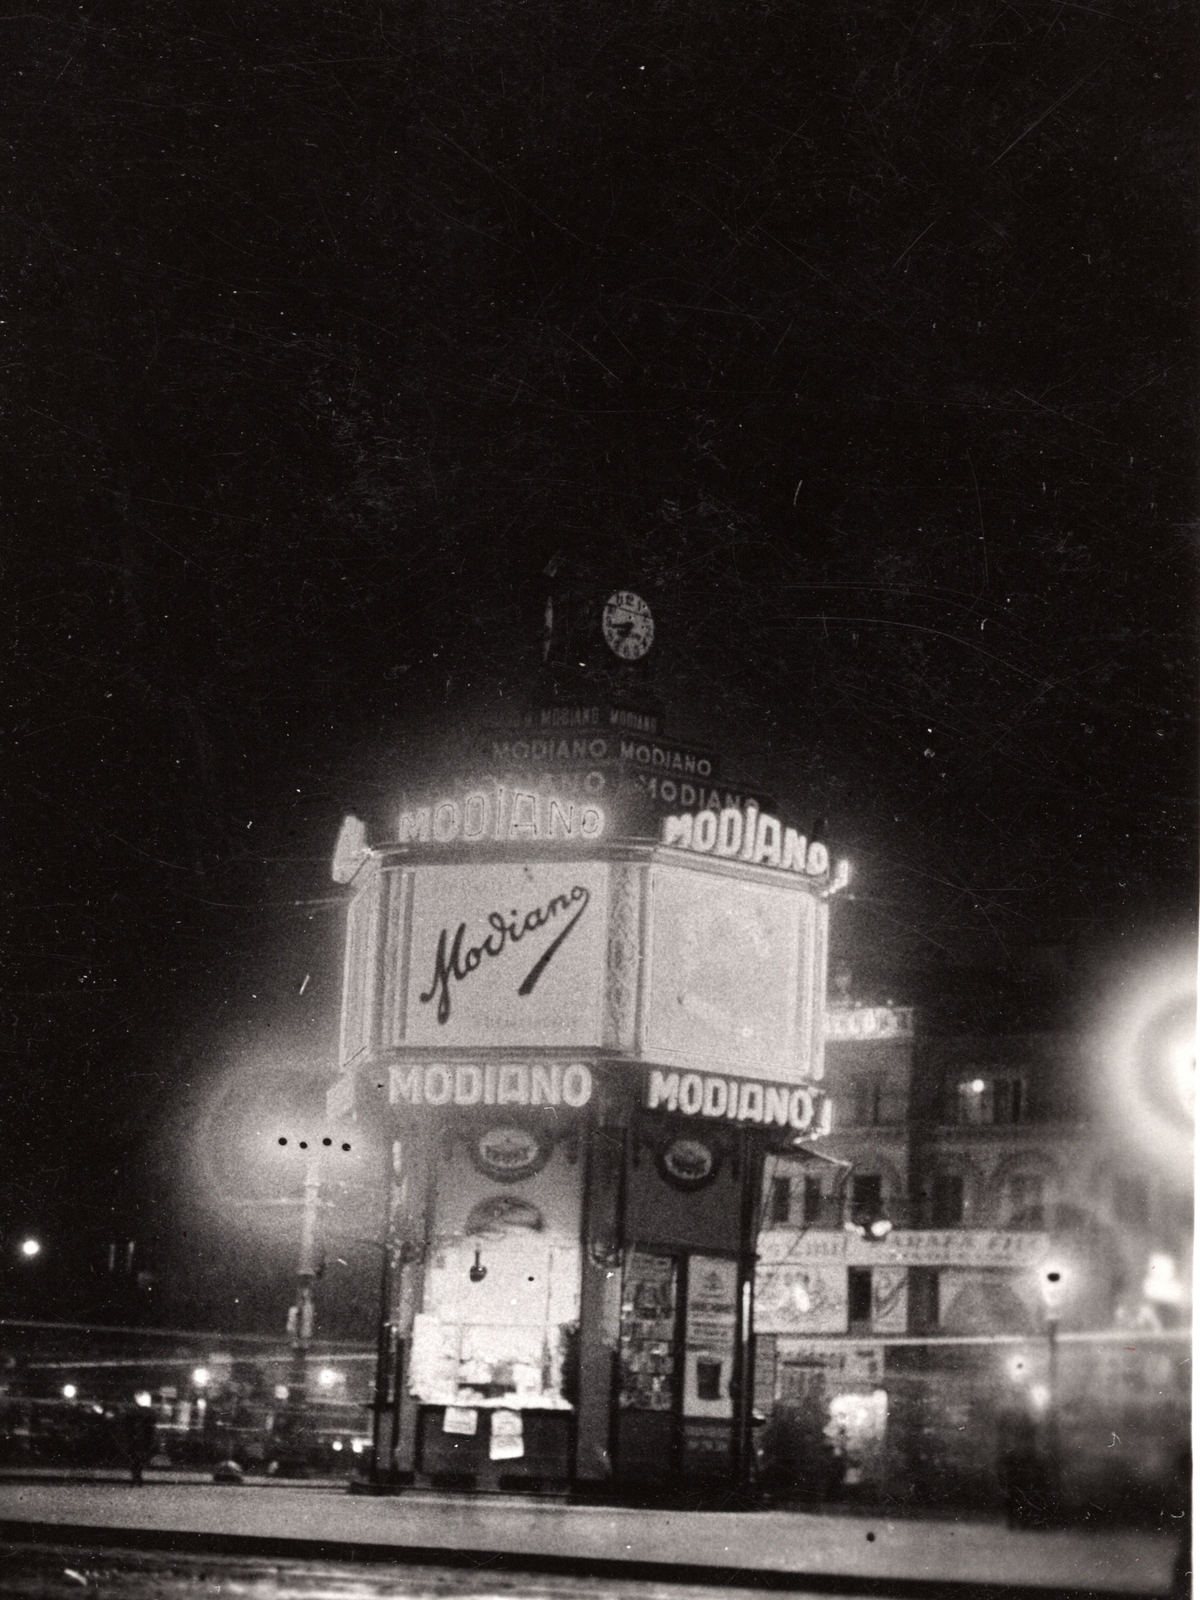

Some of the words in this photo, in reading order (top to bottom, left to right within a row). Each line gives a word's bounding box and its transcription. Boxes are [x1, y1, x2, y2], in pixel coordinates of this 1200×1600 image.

[493, 738, 607, 761] MODIANO
[620, 741, 712, 776] MODIANO
[398, 785, 606, 843] MODIANO
[663, 804, 829, 875] MODIANO
[419, 886, 591, 1025] Modiano
[388, 1063, 593, 1107] MODIANO
[648, 1071, 815, 1131] MODIANO
